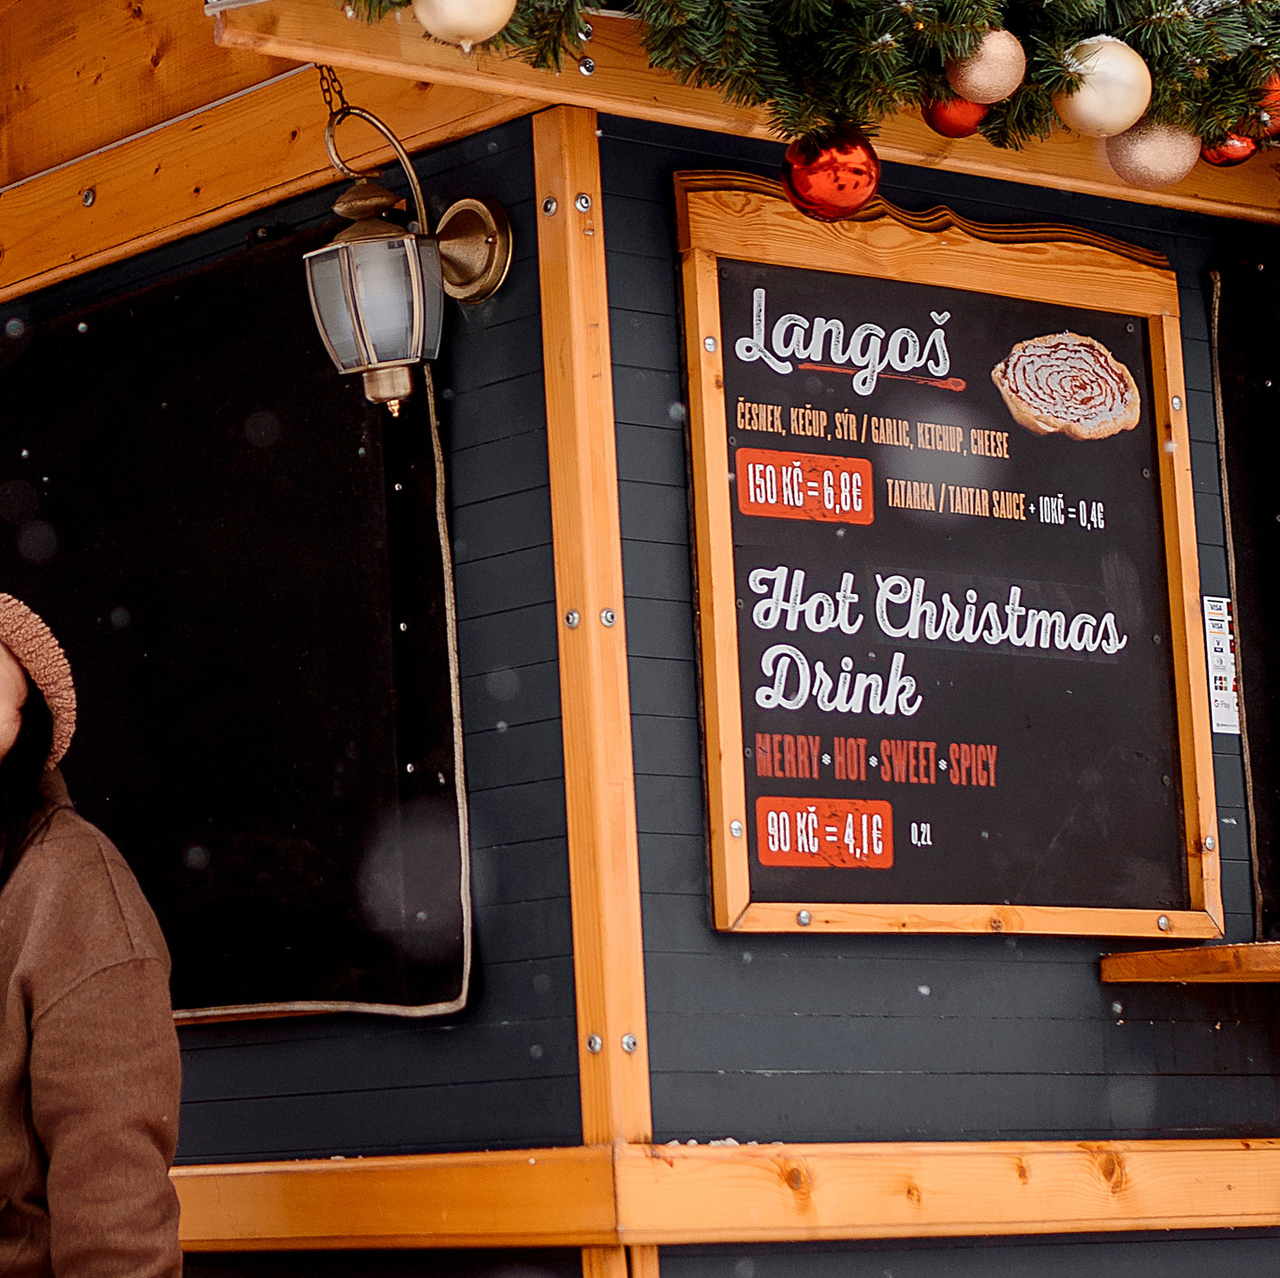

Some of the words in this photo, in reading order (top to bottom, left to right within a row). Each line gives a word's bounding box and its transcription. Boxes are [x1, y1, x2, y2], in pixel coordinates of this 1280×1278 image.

[735, 288, 951, 396] Langoš
[736, 397, 786, 436] ČESNEK,
[790, 404, 832, 441] KEČUP,
[835, 408, 858, 441] SÝR
[871, 416, 914, 451] GARLIC,
[917, 422, 967, 457] KETCHUP,
[971, 427, 1010, 459] CHEESE
[747, 463, 777, 504] 150
[781, 460, 804, 507] KČ
[823, 470, 863, 515] 6,8€
[886, 478, 936, 512] TATARKA
[948, 485, 990, 517] TARTAR
[992, 490, 1027, 521] SAUCE
[1078, 500, 1105, 531] 0,4€
[748, 566, 864, 634] Hot
[875, 572, 1128, 654] Christmas
[755, 644, 923, 716] Drink
[755, 732, 820, 780] MERRY
[833, 736, 868, 781] HOT
[880, 738, 937, 784] SWEET
[948, 742, 998, 788] SPICY
[767, 810, 790, 852] 90
[796, 805, 819, 853] KČ
[843, 812, 883, 859] 4,1€
